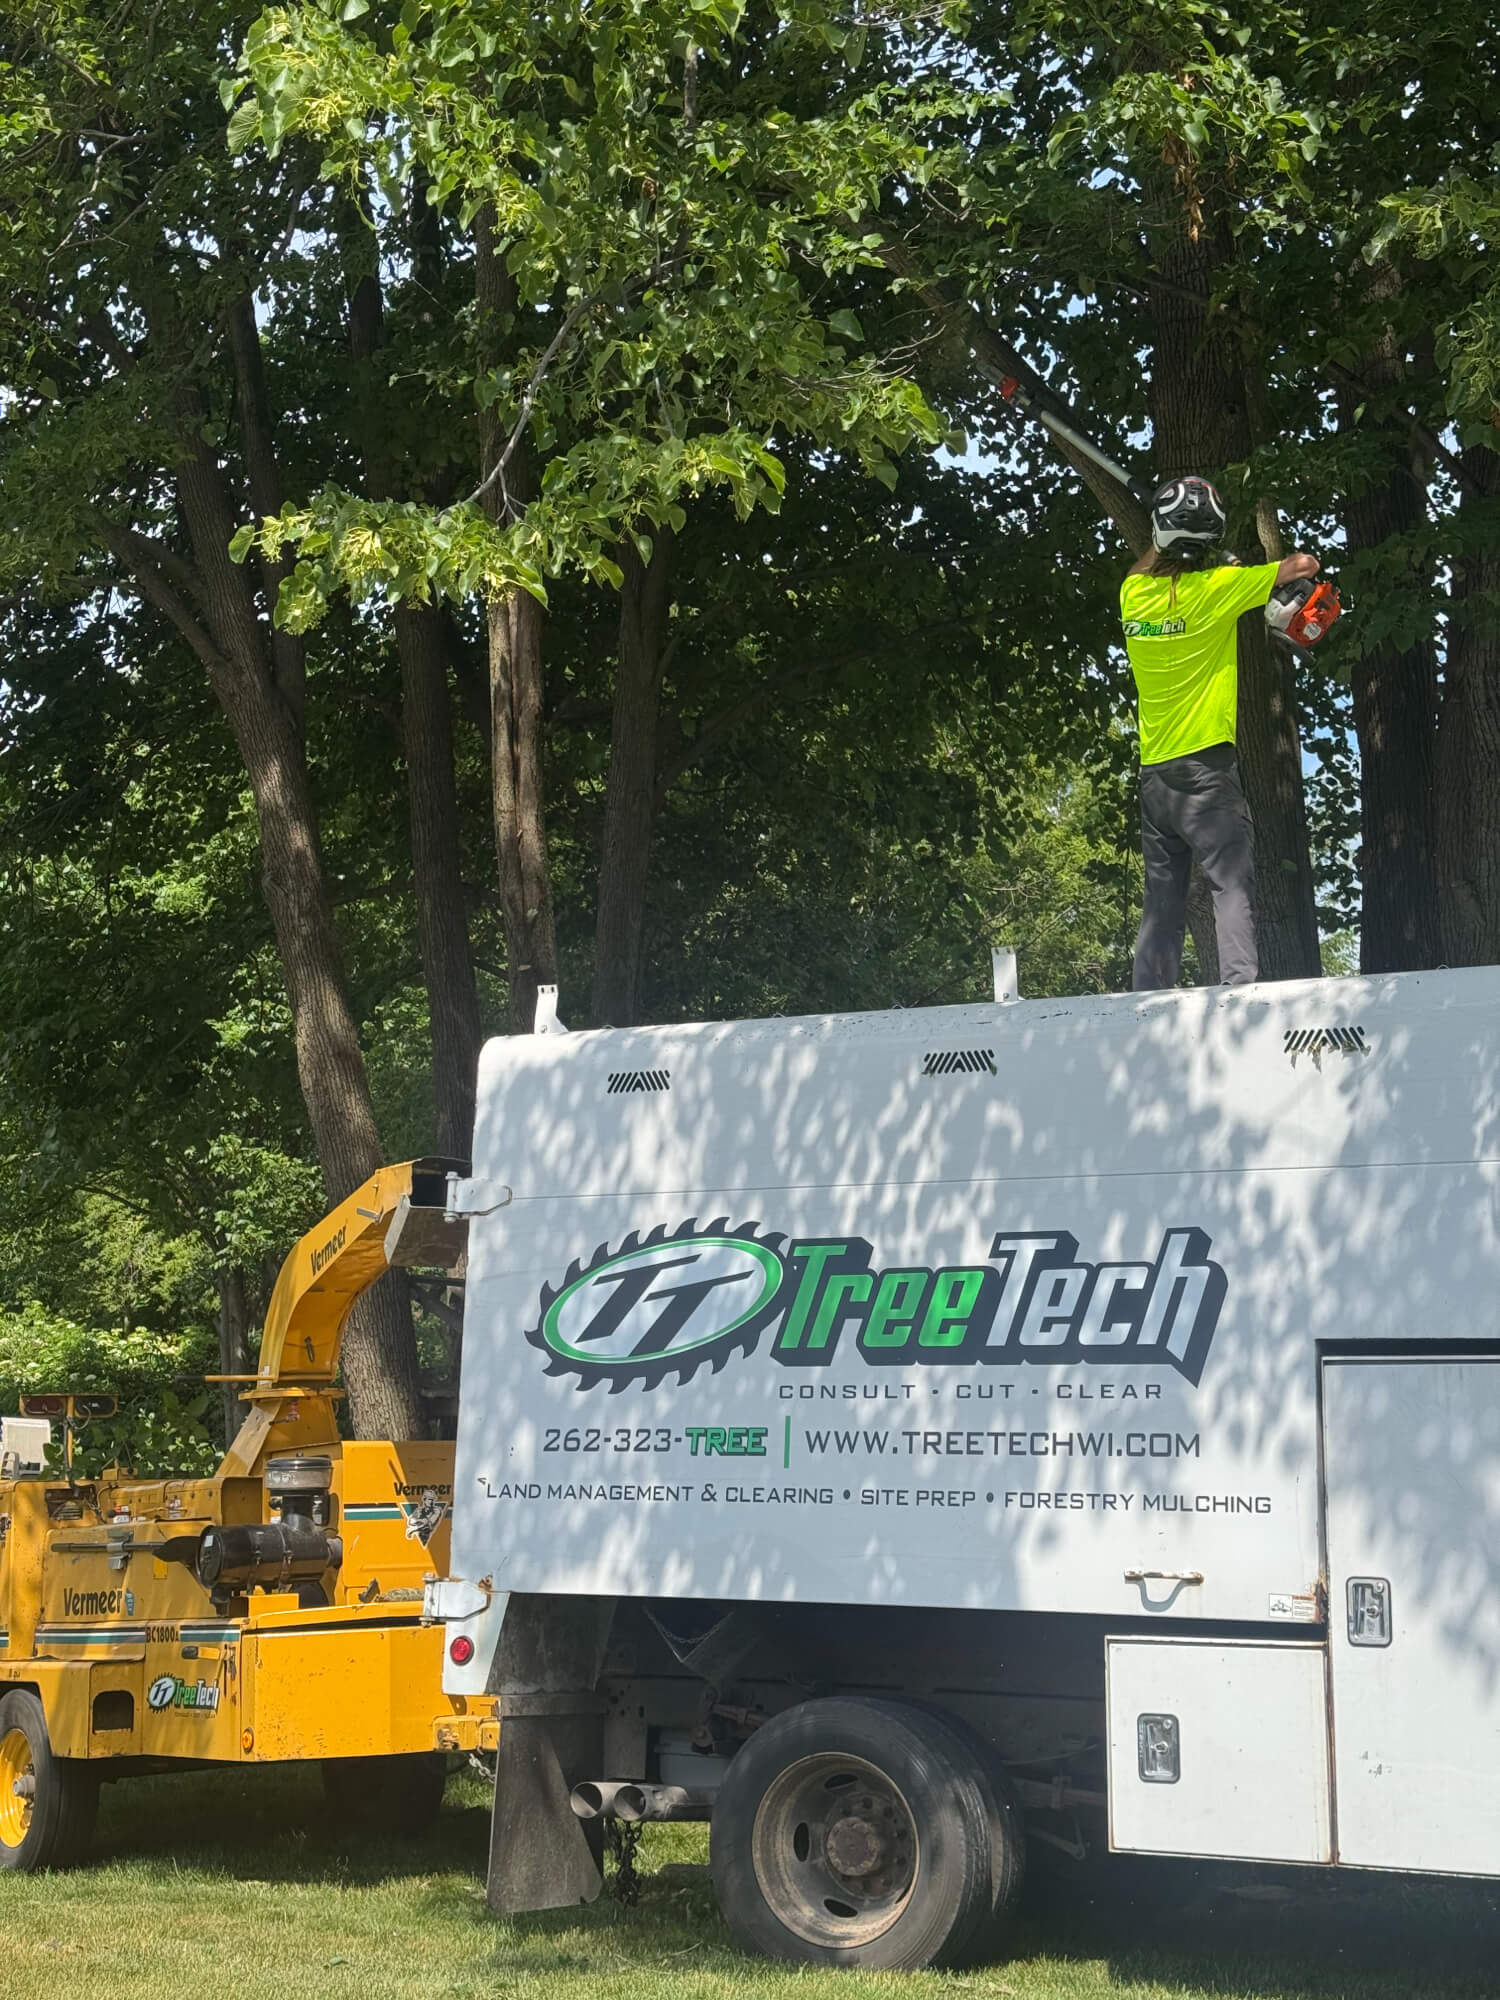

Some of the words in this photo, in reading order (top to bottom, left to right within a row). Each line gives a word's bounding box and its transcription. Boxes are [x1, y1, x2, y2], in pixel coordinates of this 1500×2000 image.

[310, 1224, 346, 1277] Vermeer
[770, 1227, 1228, 1389] TreeTech
[778, 1384, 916, 1400] CONSULT
[955, 1384, 1016, 1399] CUT
[1056, 1383, 1162, 1399] CLEAR
[543, 1427, 768, 1456] 262-323-TREE
[805, 1430, 1200, 1457] WWW.TREETECHWI.COM
[486, 1484, 542, 1499] LAND
[547, 1484, 694, 1501] MANAGEMENT
[700, 1483, 718, 1502] &
[725, 1486, 834, 1504] CLEARING
[860, 1489, 909, 1506] SITE
[915, 1490, 976, 1507] PREP
[1004, 1492, 1135, 1511] FORESTRY
[1143, 1494, 1272, 1514] MULCHING
[63, 1587, 123, 1617] Vermeer
[174, 1678, 220, 1713] TreeTech
